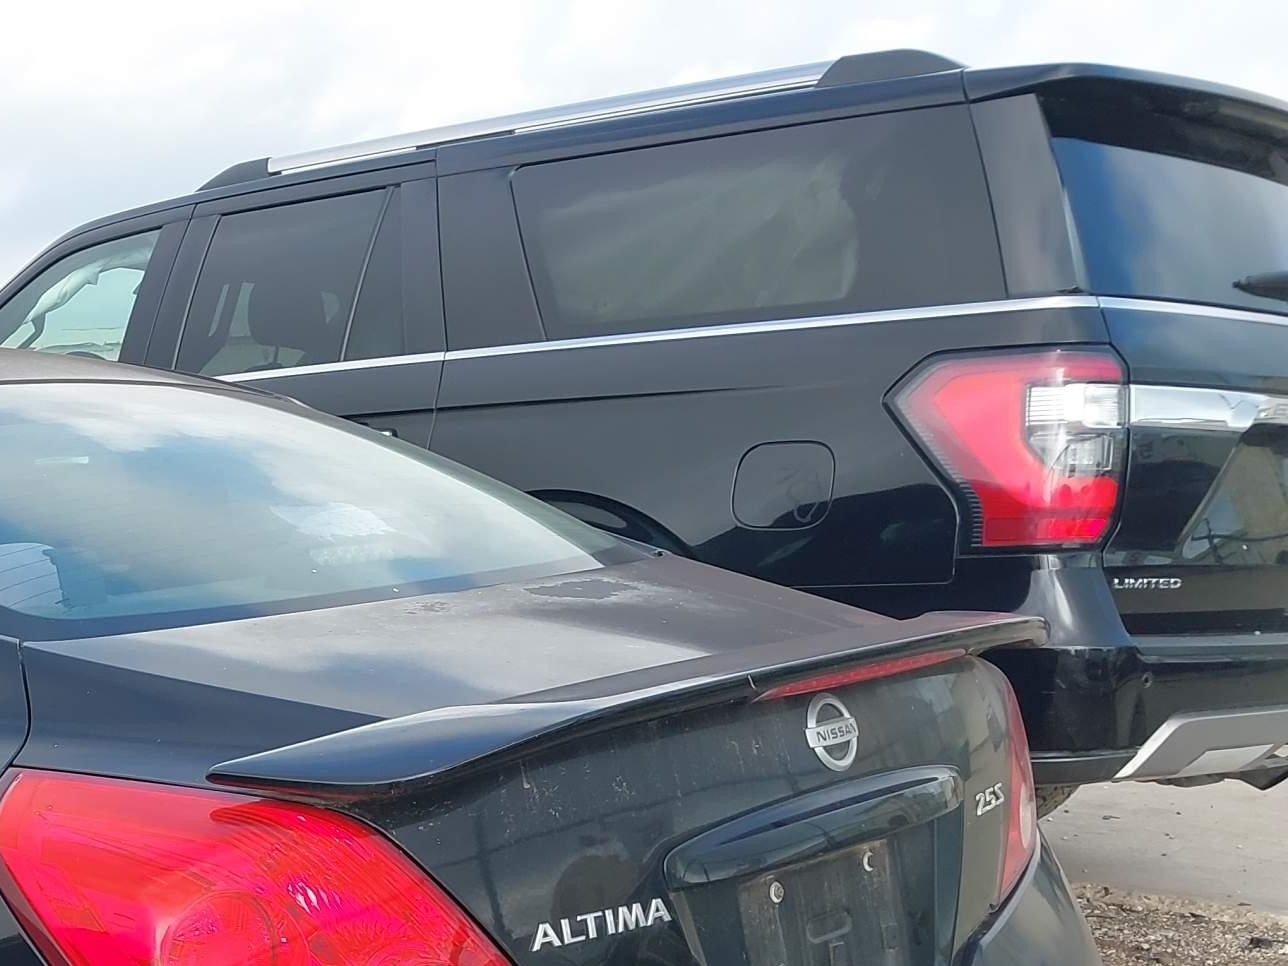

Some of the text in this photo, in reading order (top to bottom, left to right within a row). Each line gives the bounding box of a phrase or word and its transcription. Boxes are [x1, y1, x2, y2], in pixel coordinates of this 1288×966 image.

[1113, 578, 1182, 589] LIMITED
[815, 722, 857, 743] NISSAN
[529, 897, 672, 952] ALTIMA
